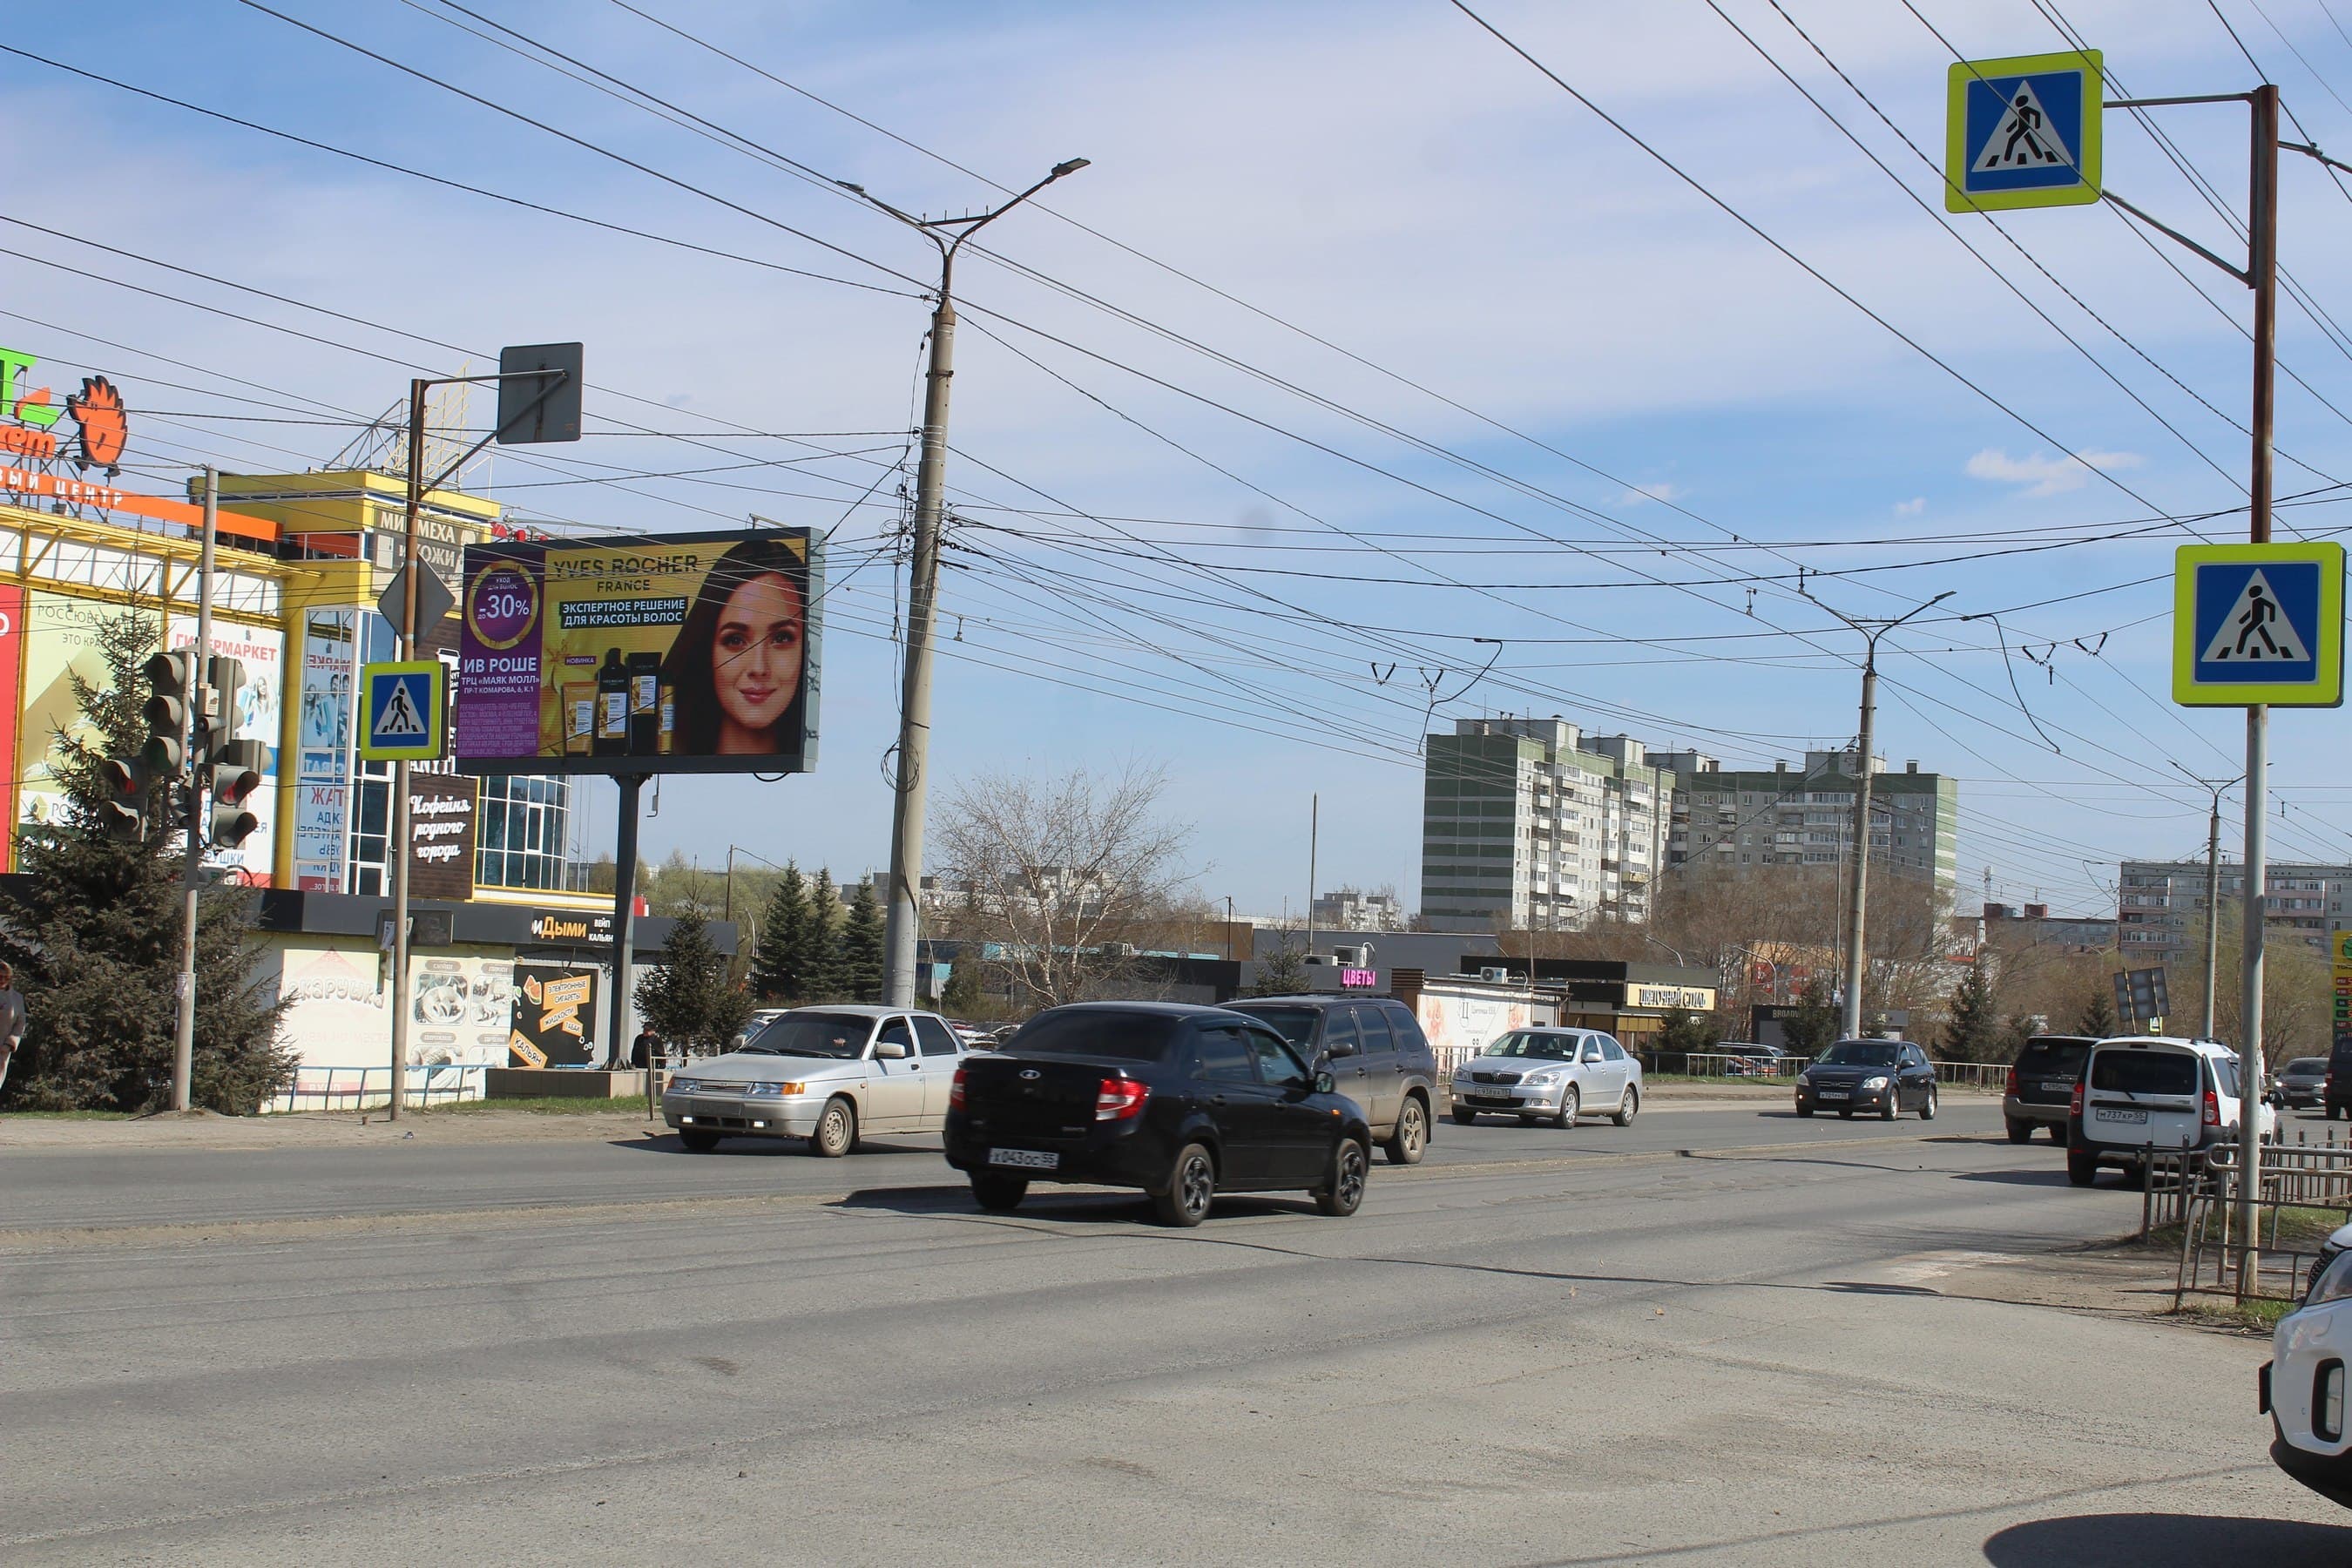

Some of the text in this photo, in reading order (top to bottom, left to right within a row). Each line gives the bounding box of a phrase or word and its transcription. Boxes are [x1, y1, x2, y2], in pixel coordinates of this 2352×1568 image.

[56, 480, 123, 505] ЦЕНТР
[381, 511, 456, 544] МИ МЕХА
[418, 544, 455, 567] ОЖИ
[553, 555, 698, 578] YVES ROCHER
[597, 579, 651, 593] FRANCE
[479, 593, 530, 618] -30%
[563, 598, 686, 613] ЭКСПЕРТНОЕ РЕШЕНИЕ
[564, 612, 682, 626] ДЛЯ КРАСОТЫ ВОЛОС
[176, 633, 277, 662] ГИЕРМАРКЕТ
[464, 657, 537, 673] ИВ РОШЕ
[462, 677, 477, 686] ТРЦ
[478, 676, 507, 685] «МАЯК
[509, 675, 539, 685] МОЛЛ»
[409, 794, 471, 820] Кофейня
[413, 821, 466, 841] родного
[416, 843, 461, 863] города
[594, 917, 611, 928] ВЕЙП
[588, 933, 614, 943] КАЛЬЯН
[548, 980, 586, 994] ЭЛЕКТРОННЫЕ
[1342, 969, 1376, 987] ЦВЕТЫ
[555, 992, 581, 1004] СИГАРЕТЫ
[544, 1007, 575, 1026] ЖИДКОСТИ
[564, 1021, 580, 1033] ТАБАК
[515, 1037, 542, 1065] КАЛЬЯН
